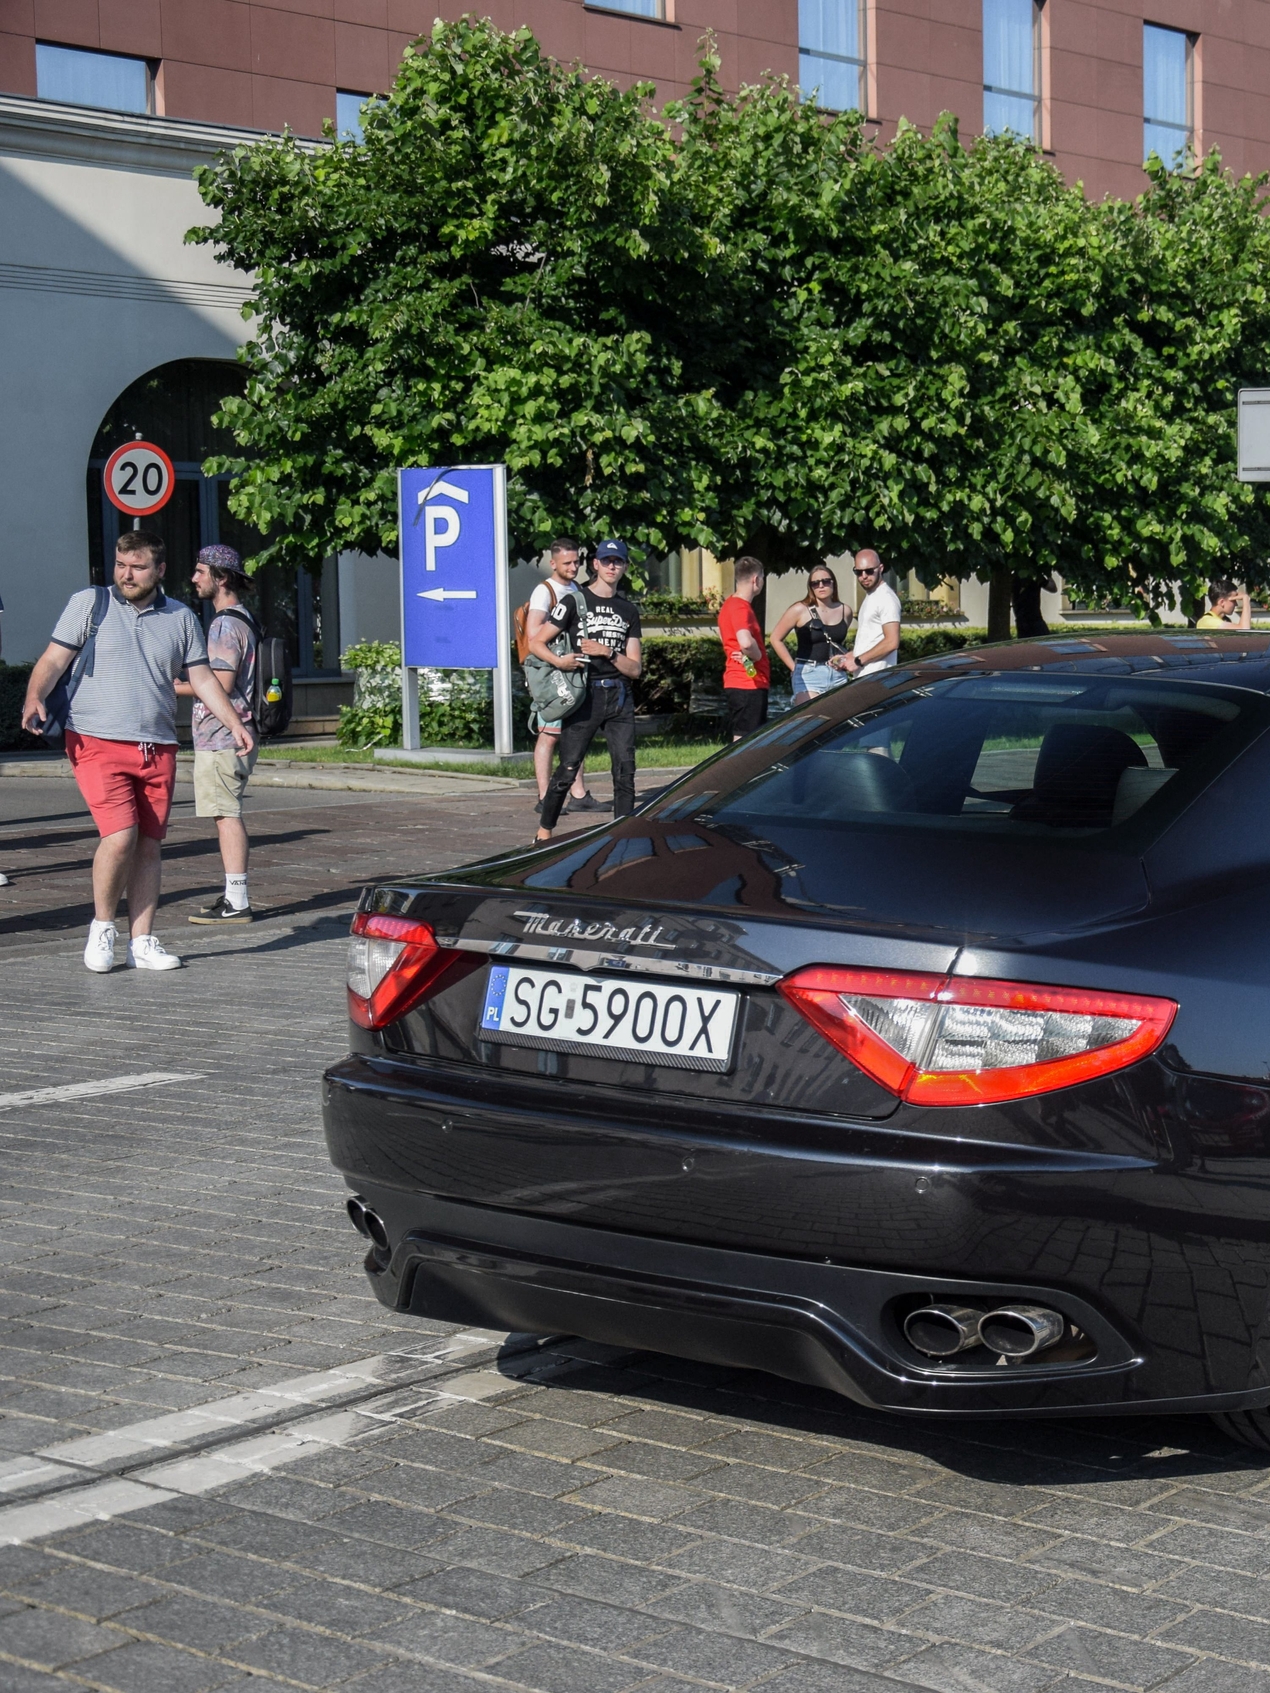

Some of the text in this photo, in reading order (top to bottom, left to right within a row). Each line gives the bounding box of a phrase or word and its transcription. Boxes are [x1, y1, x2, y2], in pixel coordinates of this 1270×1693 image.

[118, 461, 164, 496] 20
[425, 505, 460, 571] P
[595, 606, 614, 614] REAL
[513, 910, 677, 950] Maserati
[487, 1006, 499, 1022] PL
[509, 976, 722, 1054] SG 5900X
